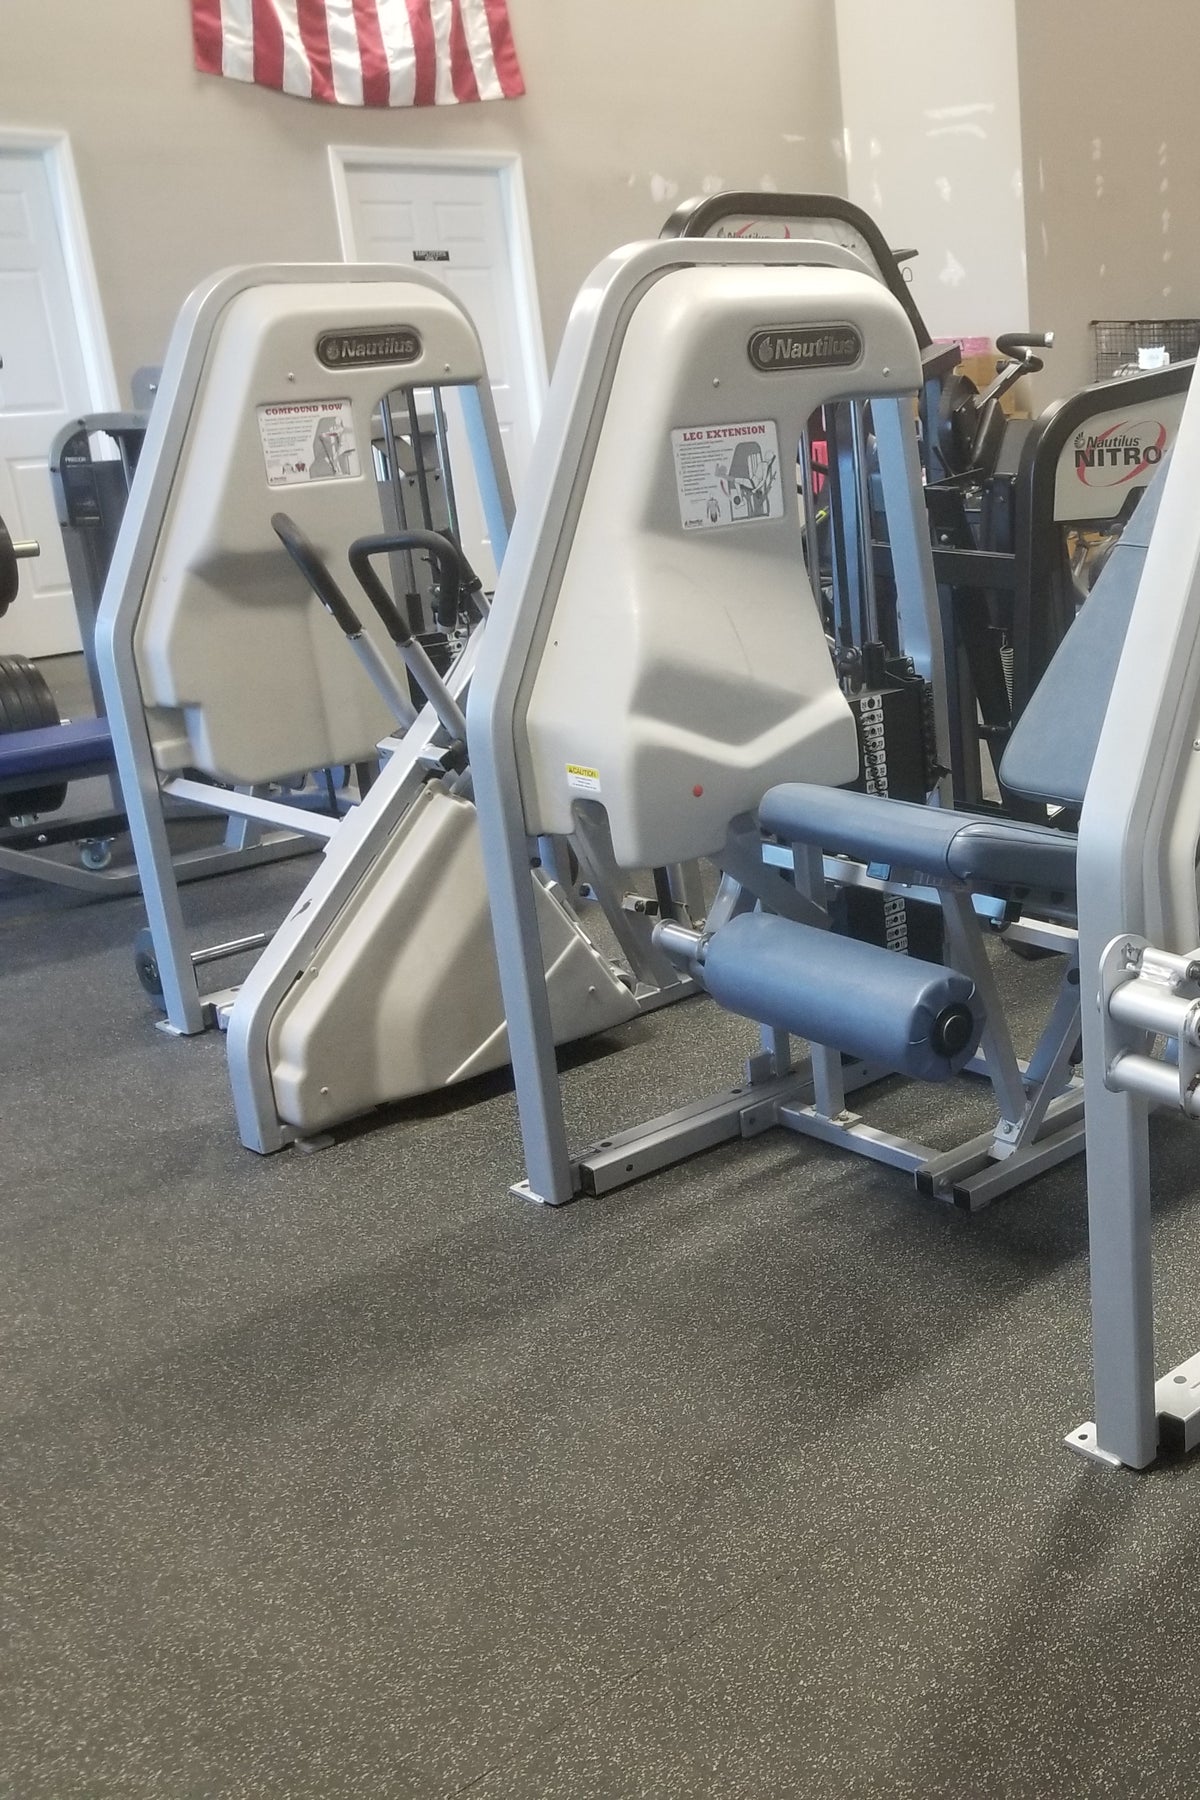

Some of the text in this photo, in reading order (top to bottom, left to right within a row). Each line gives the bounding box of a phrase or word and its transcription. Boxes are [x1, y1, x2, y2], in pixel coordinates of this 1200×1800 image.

[341, 336, 414, 358] Nautilus
[775, 335, 854, 360] Nautilus
[265, 403, 343, 416] COMPOUND ROW
[683, 425, 766, 441] LEG EXTENSION
[1087, 435, 1140, 449] Nautilus
[1075, 445, 1162, 468] NITRO
